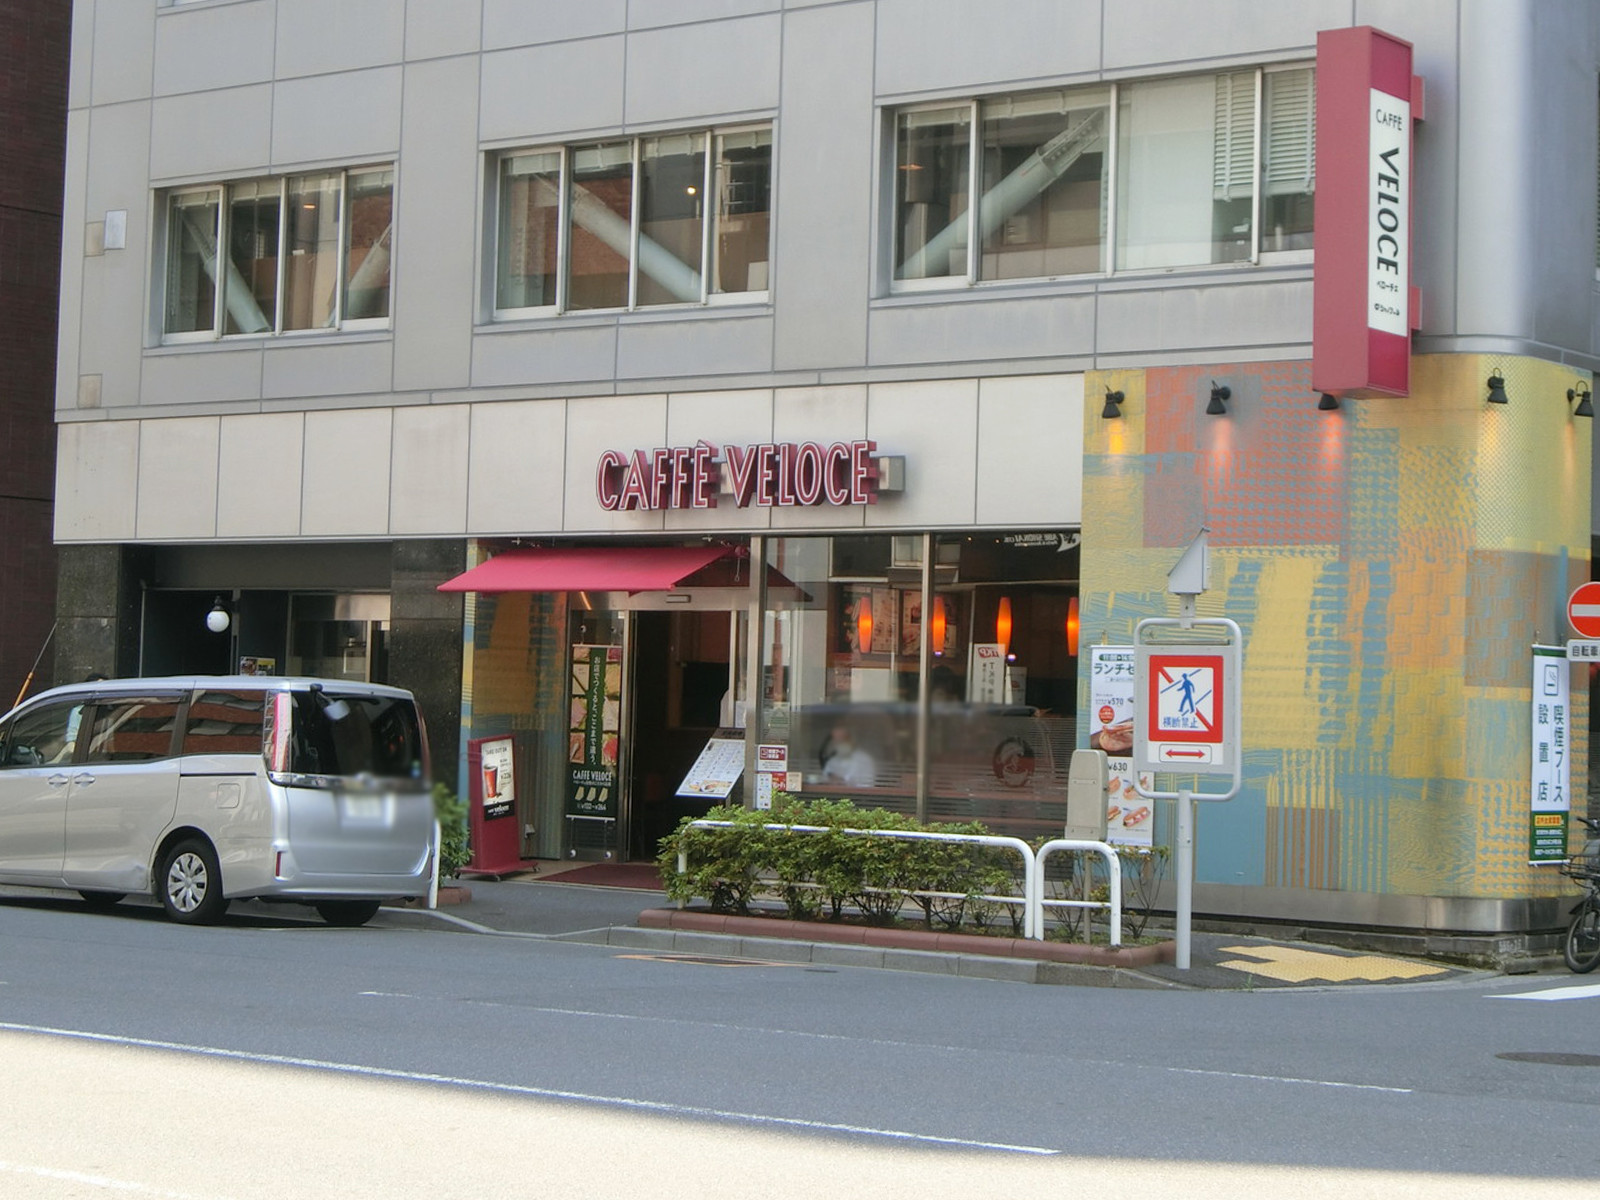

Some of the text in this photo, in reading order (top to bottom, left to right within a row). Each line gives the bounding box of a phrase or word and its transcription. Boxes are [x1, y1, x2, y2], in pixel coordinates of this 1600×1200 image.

[1377, 147, 1400, 276] VELOCE
[595, 439, 877, 511] CAFFÈ VELOCE
[1163, 716, 1199, 729] 横断禁止
[1538, 703, 1549, 802] 設置店
[1553, 705, 1564, 802] 喫煙ブース
